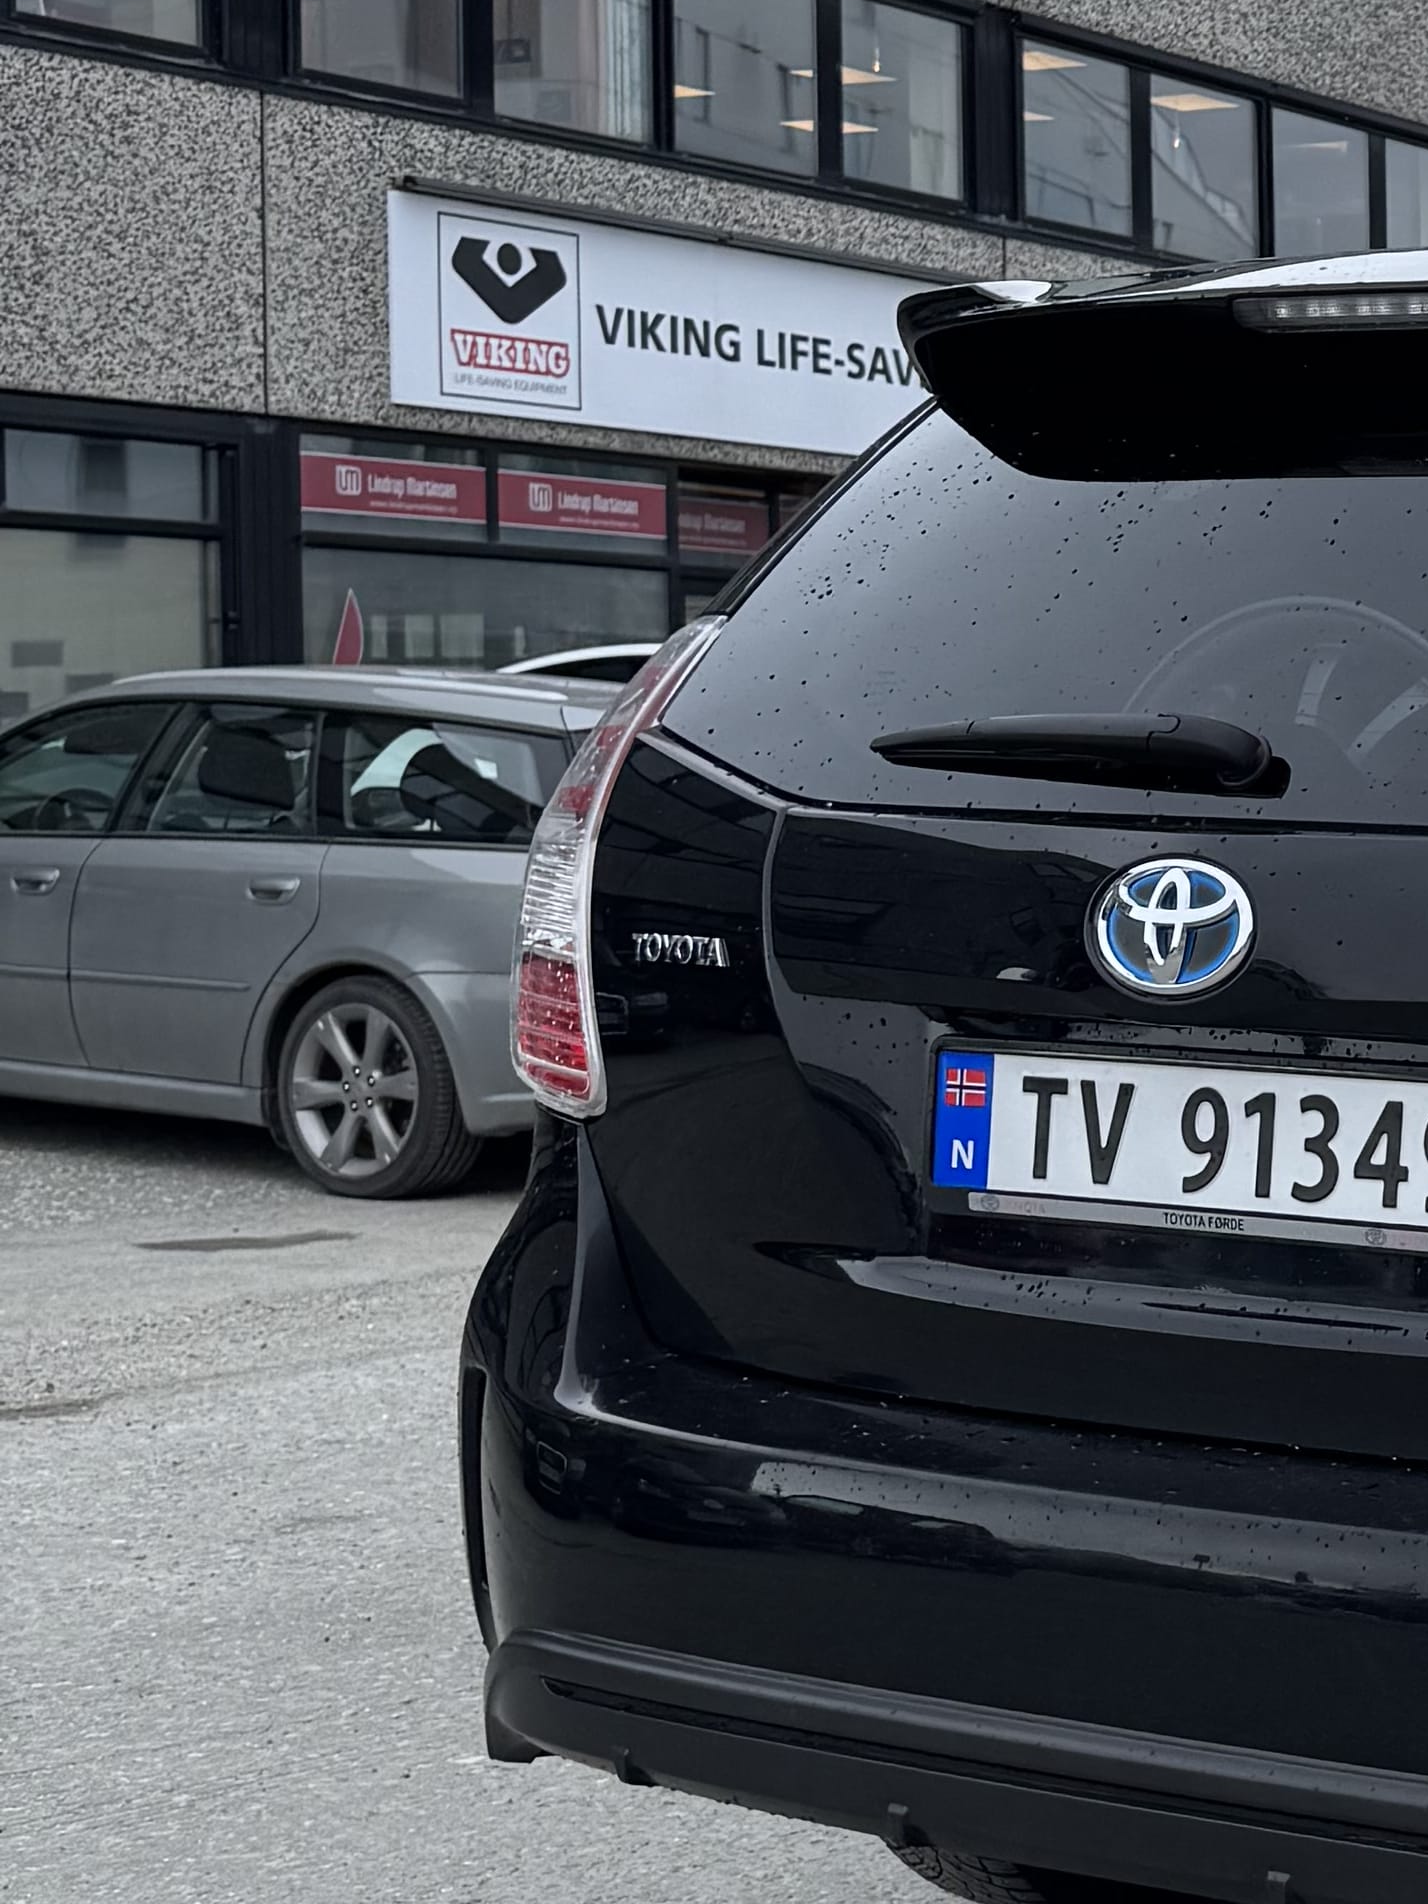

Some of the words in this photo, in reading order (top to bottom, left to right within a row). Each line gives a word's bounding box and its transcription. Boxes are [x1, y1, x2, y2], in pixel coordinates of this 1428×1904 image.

[453, 332, 569, 376] VIKING
[594, 303, 742, 363] VIKING
[757, 328, 928, 388] LIFE-SAV
[454, 373, 513, 390] LIFE-SAVING
[514, 379, 568, 395] EQUIPMENT
[631, 932, 731, 968] TOYOTA
[1022, 1075, 1136, 1185] TV
[950, 1138, 974, 1171] N
[1163, 1211, 1206, 1228] TOYOTA
[1208, 1215, 1245, 1232] FØRDE
